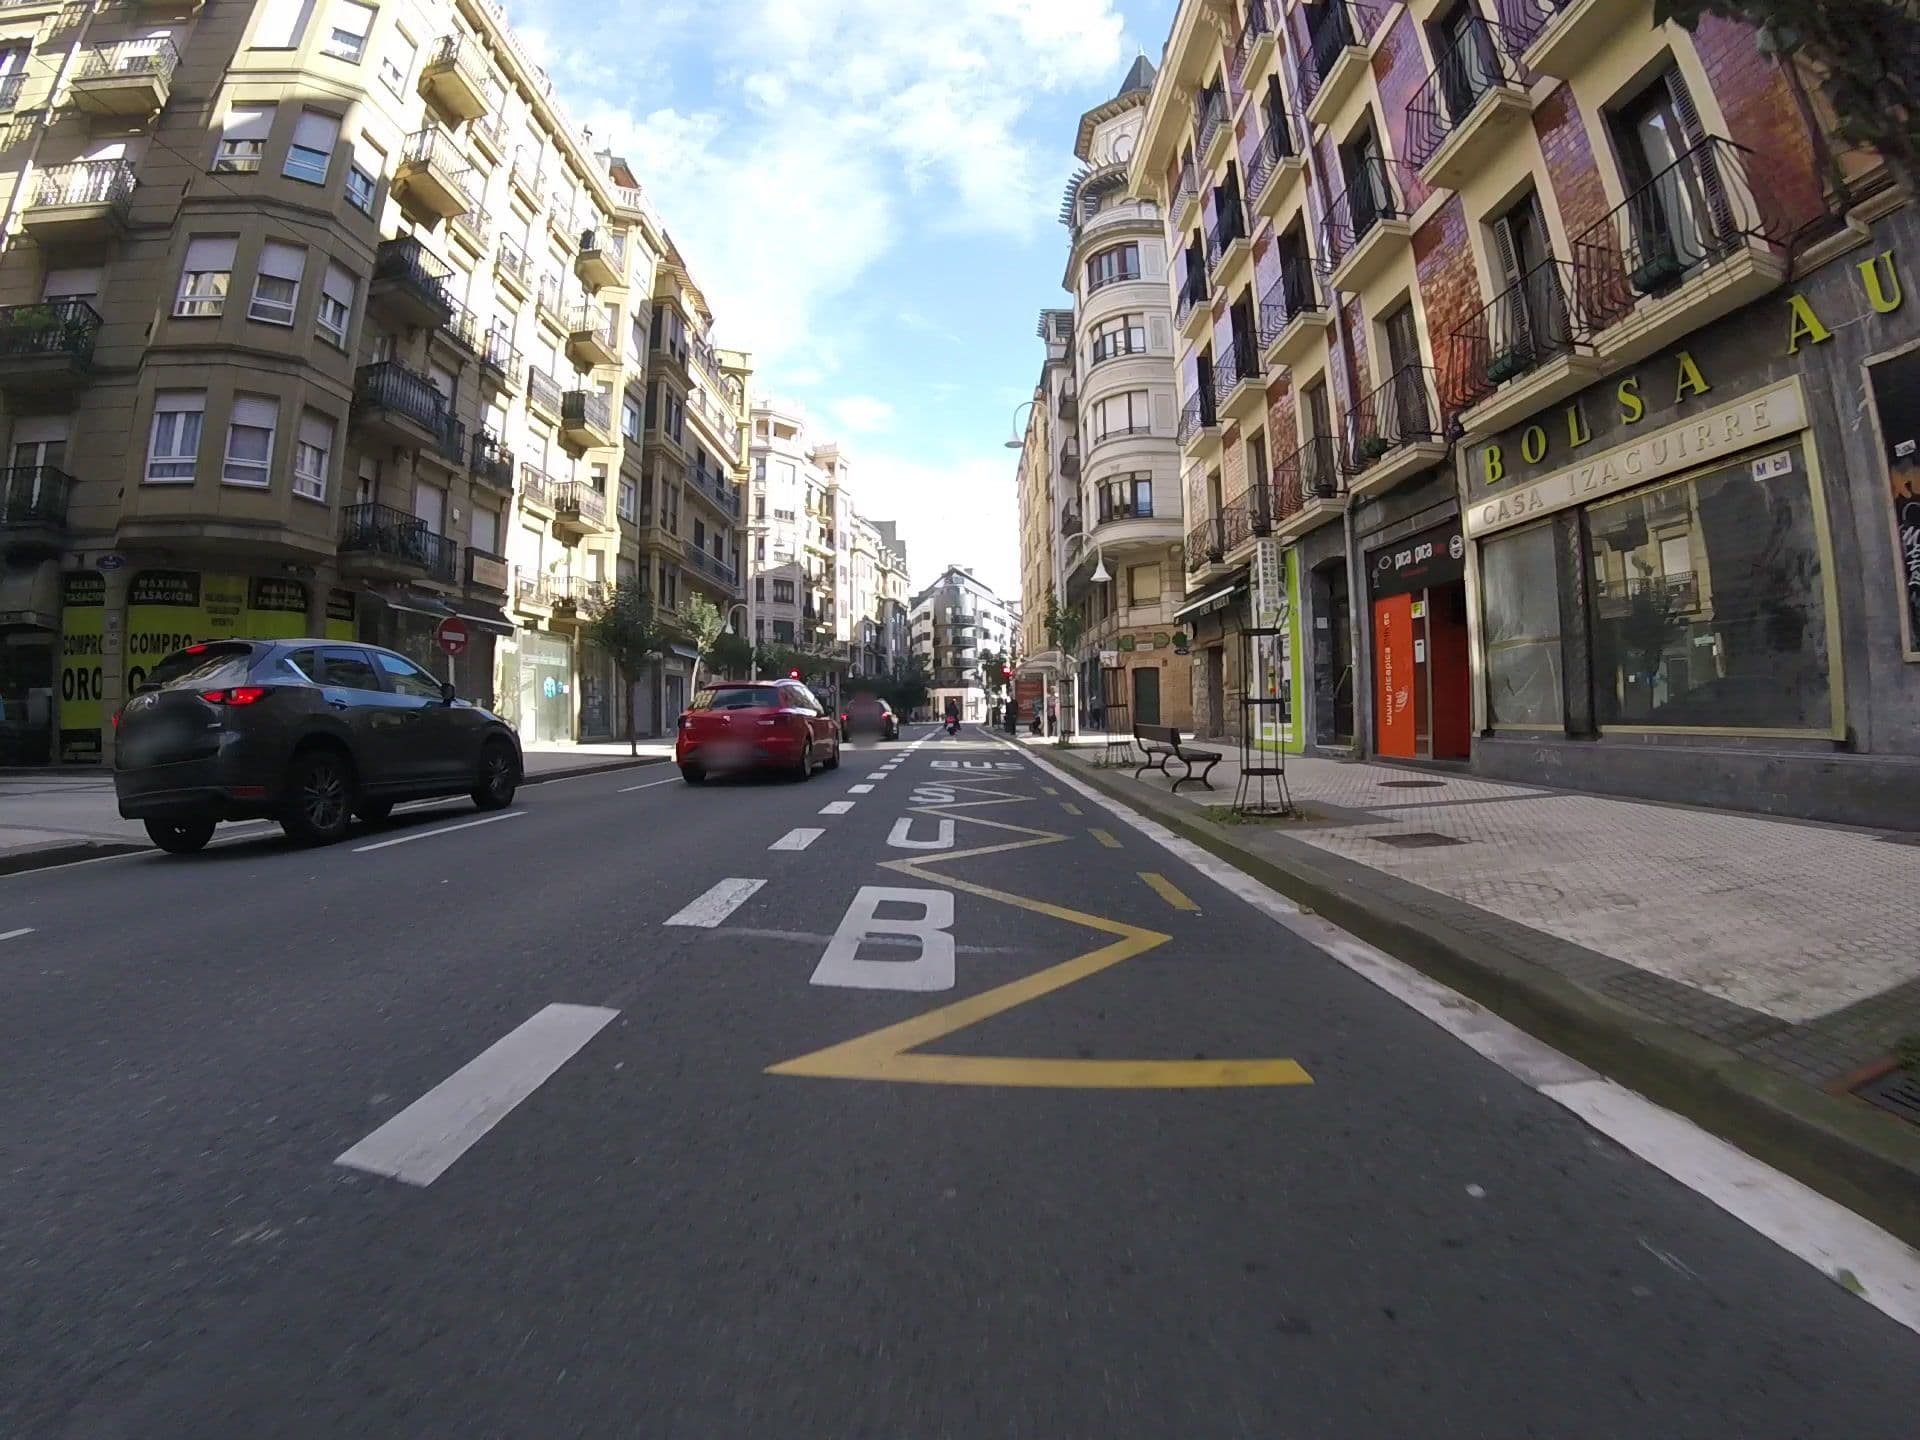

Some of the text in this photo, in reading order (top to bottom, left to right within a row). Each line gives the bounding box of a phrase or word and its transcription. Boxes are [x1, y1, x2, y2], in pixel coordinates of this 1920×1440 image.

[1483, 350, 1711, 485] BOLSA
[1482, 398, 1772, 526] CASA IZAGUIRRE
[138, 578, 188, 589] MAXIMA
[132, 591, 193, 602] TASACION
[130, 633, 193, 655] COMPRO
[929, 759, 1025, 771] BUS
